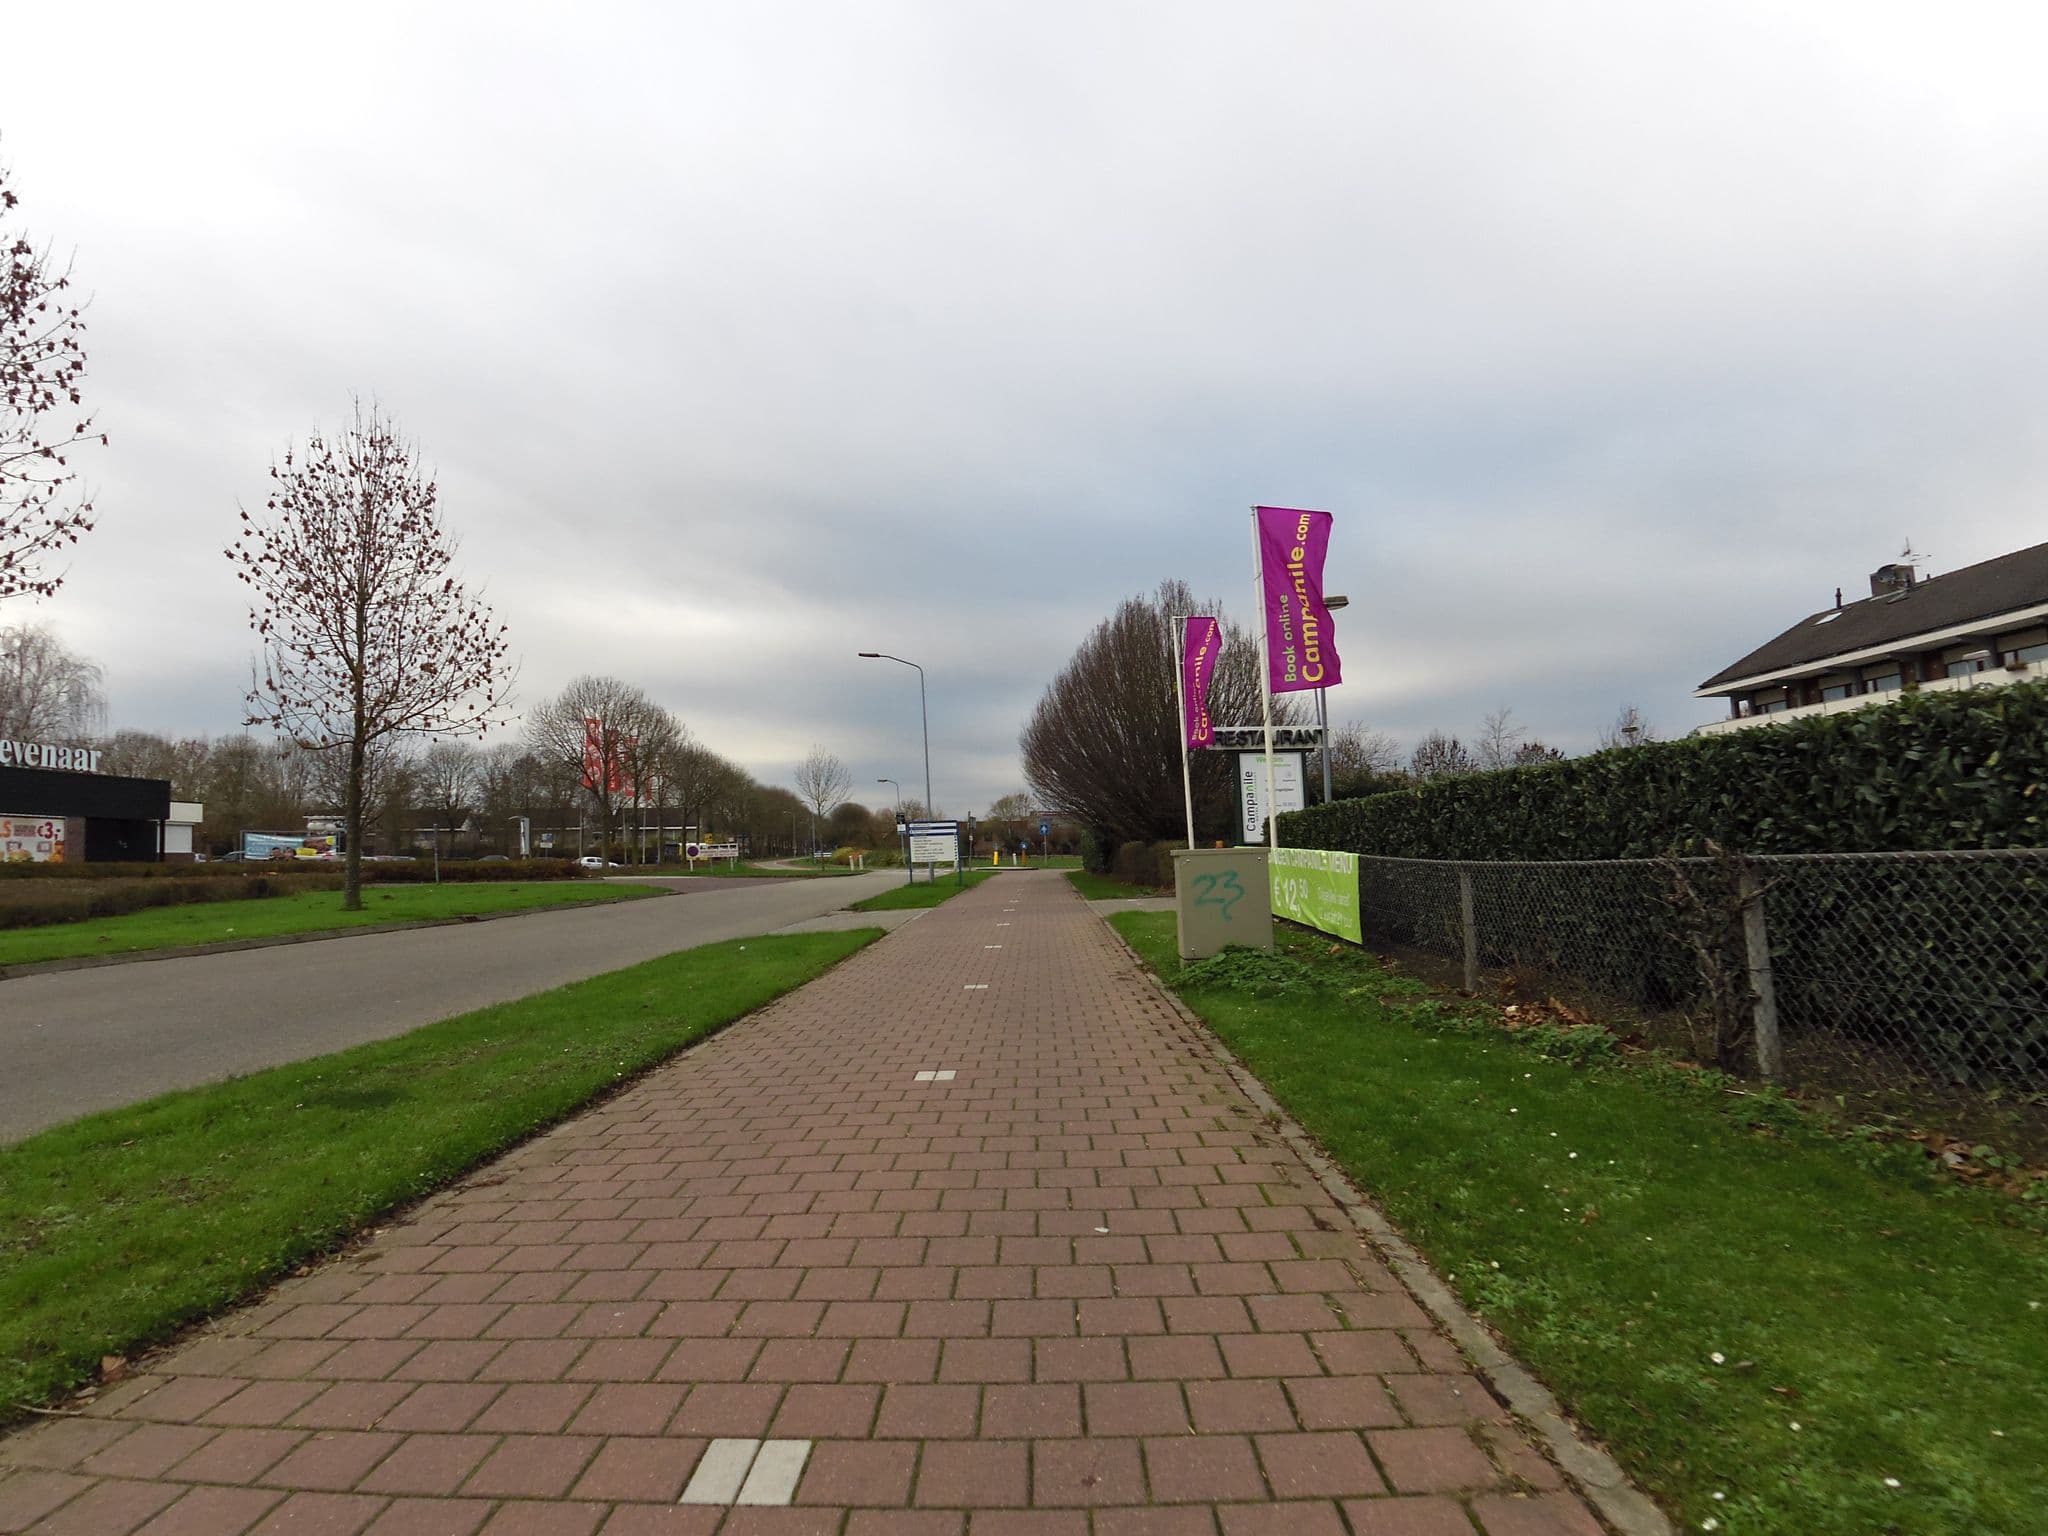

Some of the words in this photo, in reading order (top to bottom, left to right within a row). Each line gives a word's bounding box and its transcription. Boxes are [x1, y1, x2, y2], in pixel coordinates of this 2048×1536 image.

[1279, 594, 1293, 641] online
[1287, 513, 1324, 682] Campanile.com
[1195, 620, 1216, 741] Caanile.com
[1282, 645, 1297, 682] Book
[1243, 771, 1258, 832] Campanile
